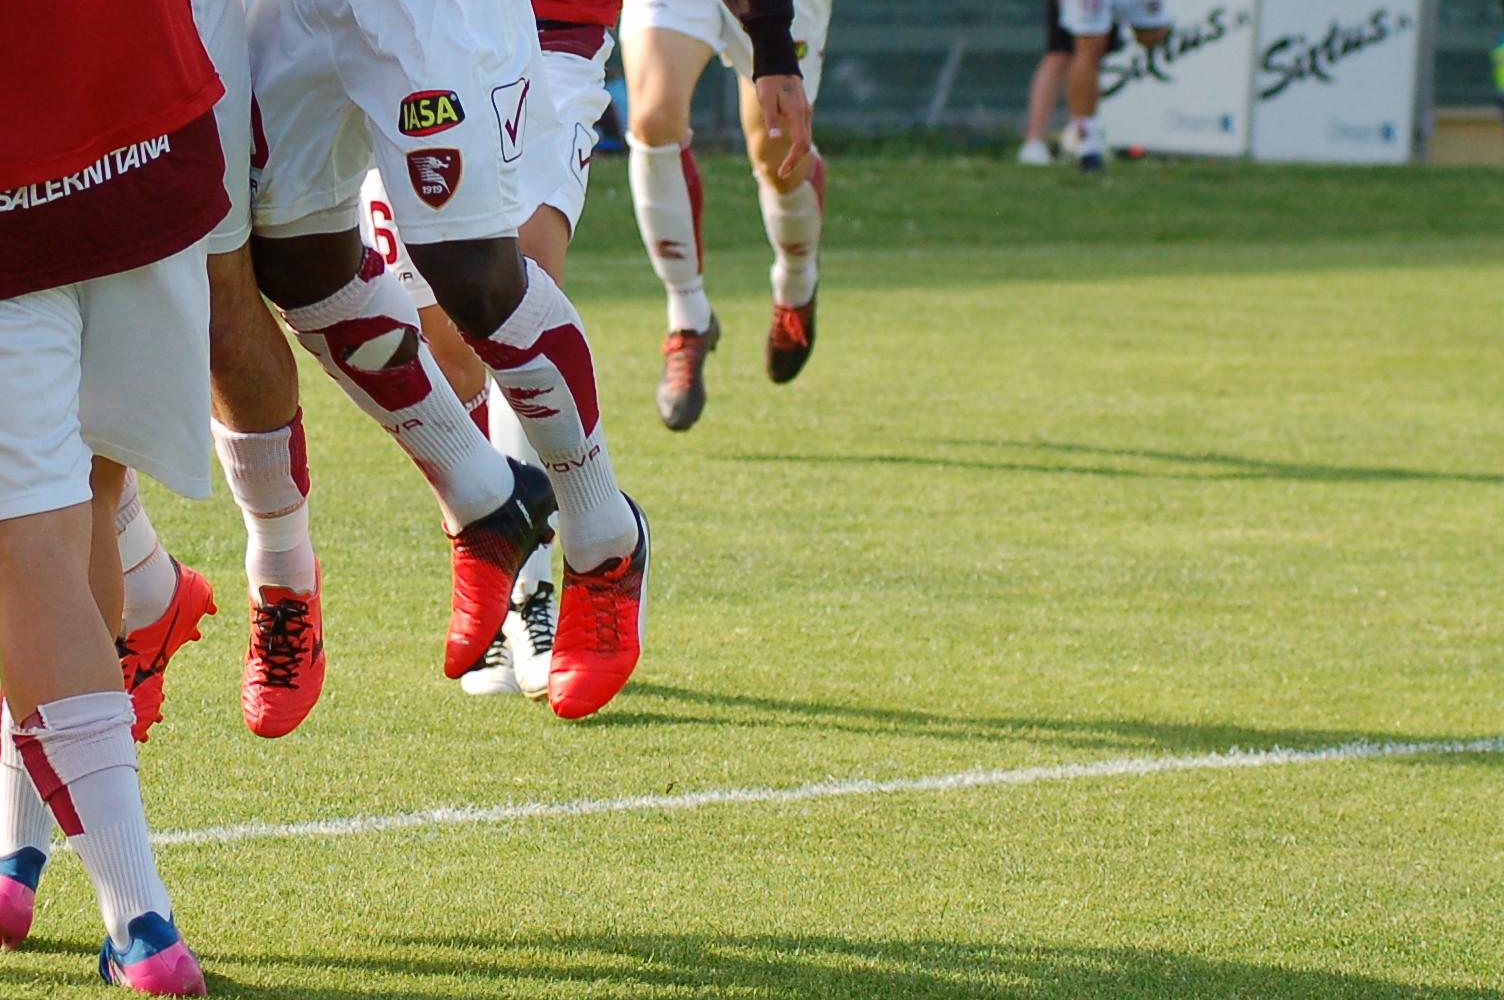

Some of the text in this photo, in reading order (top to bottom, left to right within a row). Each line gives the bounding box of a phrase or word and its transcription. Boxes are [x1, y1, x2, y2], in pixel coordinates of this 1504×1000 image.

[403, 95, 456, 130] IASA
[421, 185, 444, 195] 1919
[369, 200, 398, 265] 6
